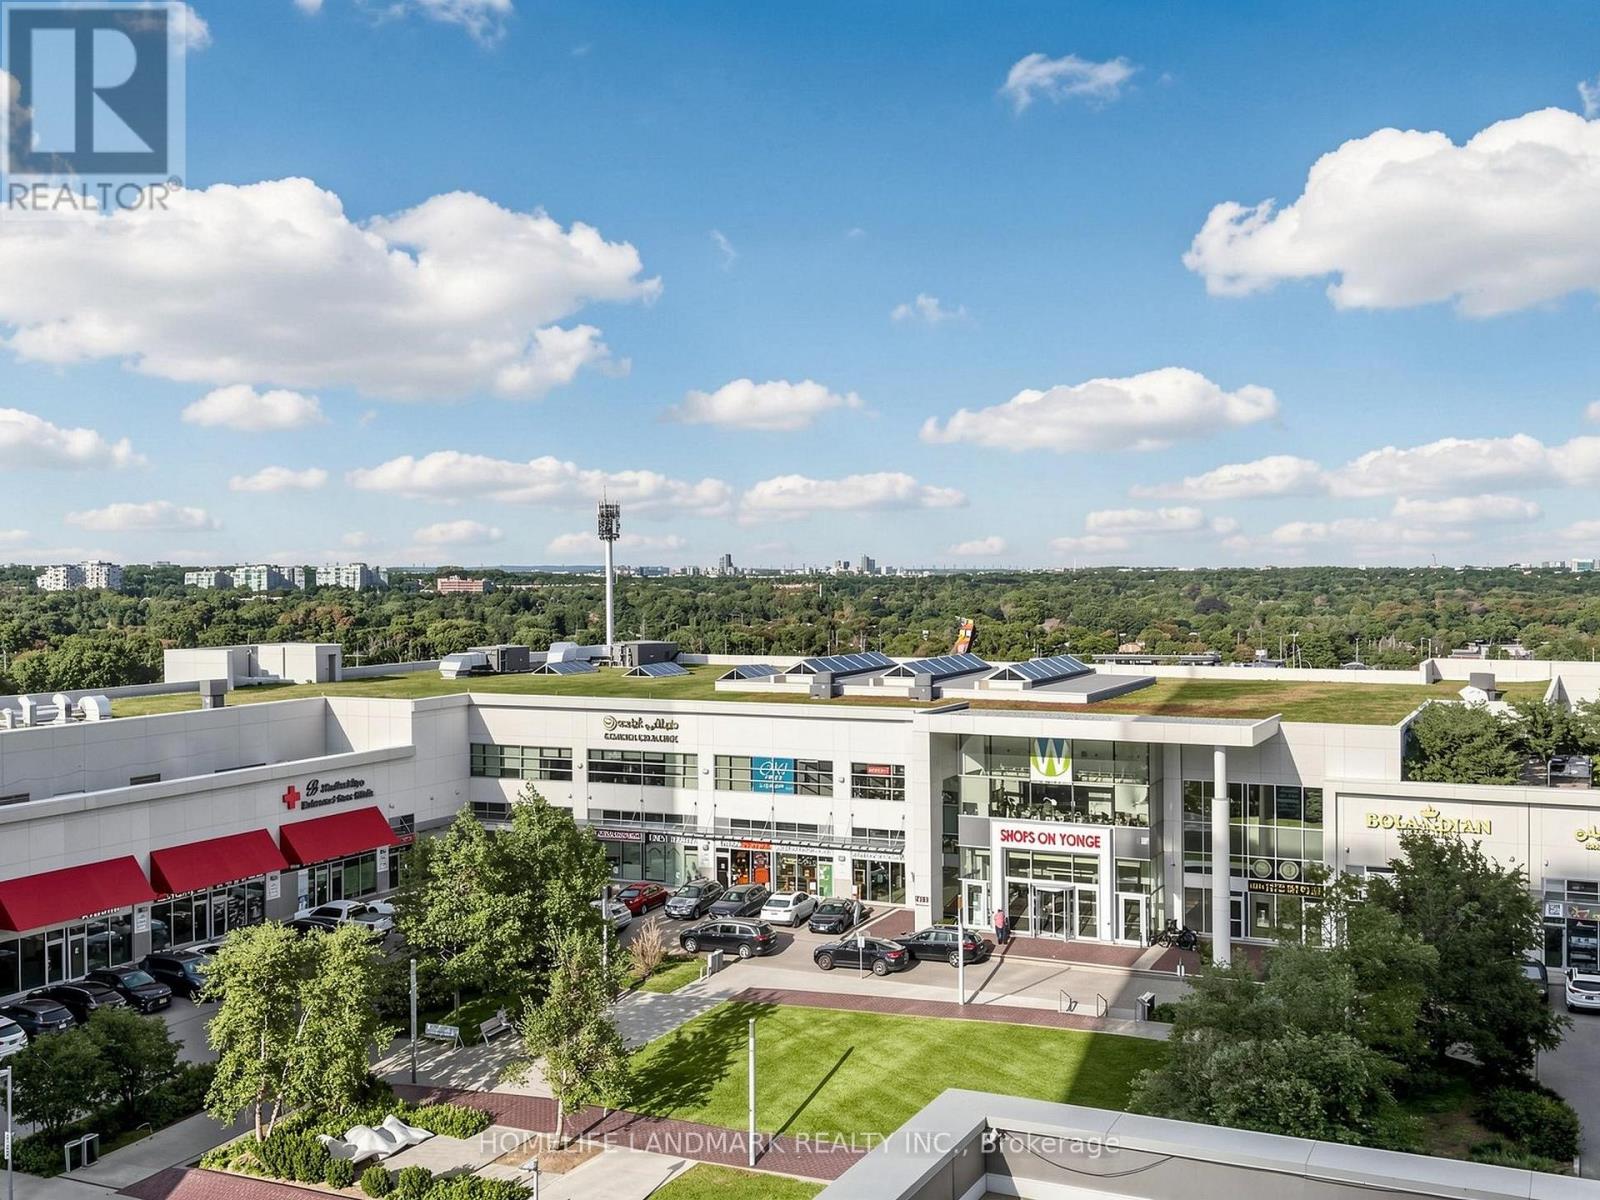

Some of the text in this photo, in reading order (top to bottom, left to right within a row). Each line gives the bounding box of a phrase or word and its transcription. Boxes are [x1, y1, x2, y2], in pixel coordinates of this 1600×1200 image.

[1365, 812, 1493, 835] BOLANDIAN
[1000, 829, 1101, 848] SHOPS ON YONGE
